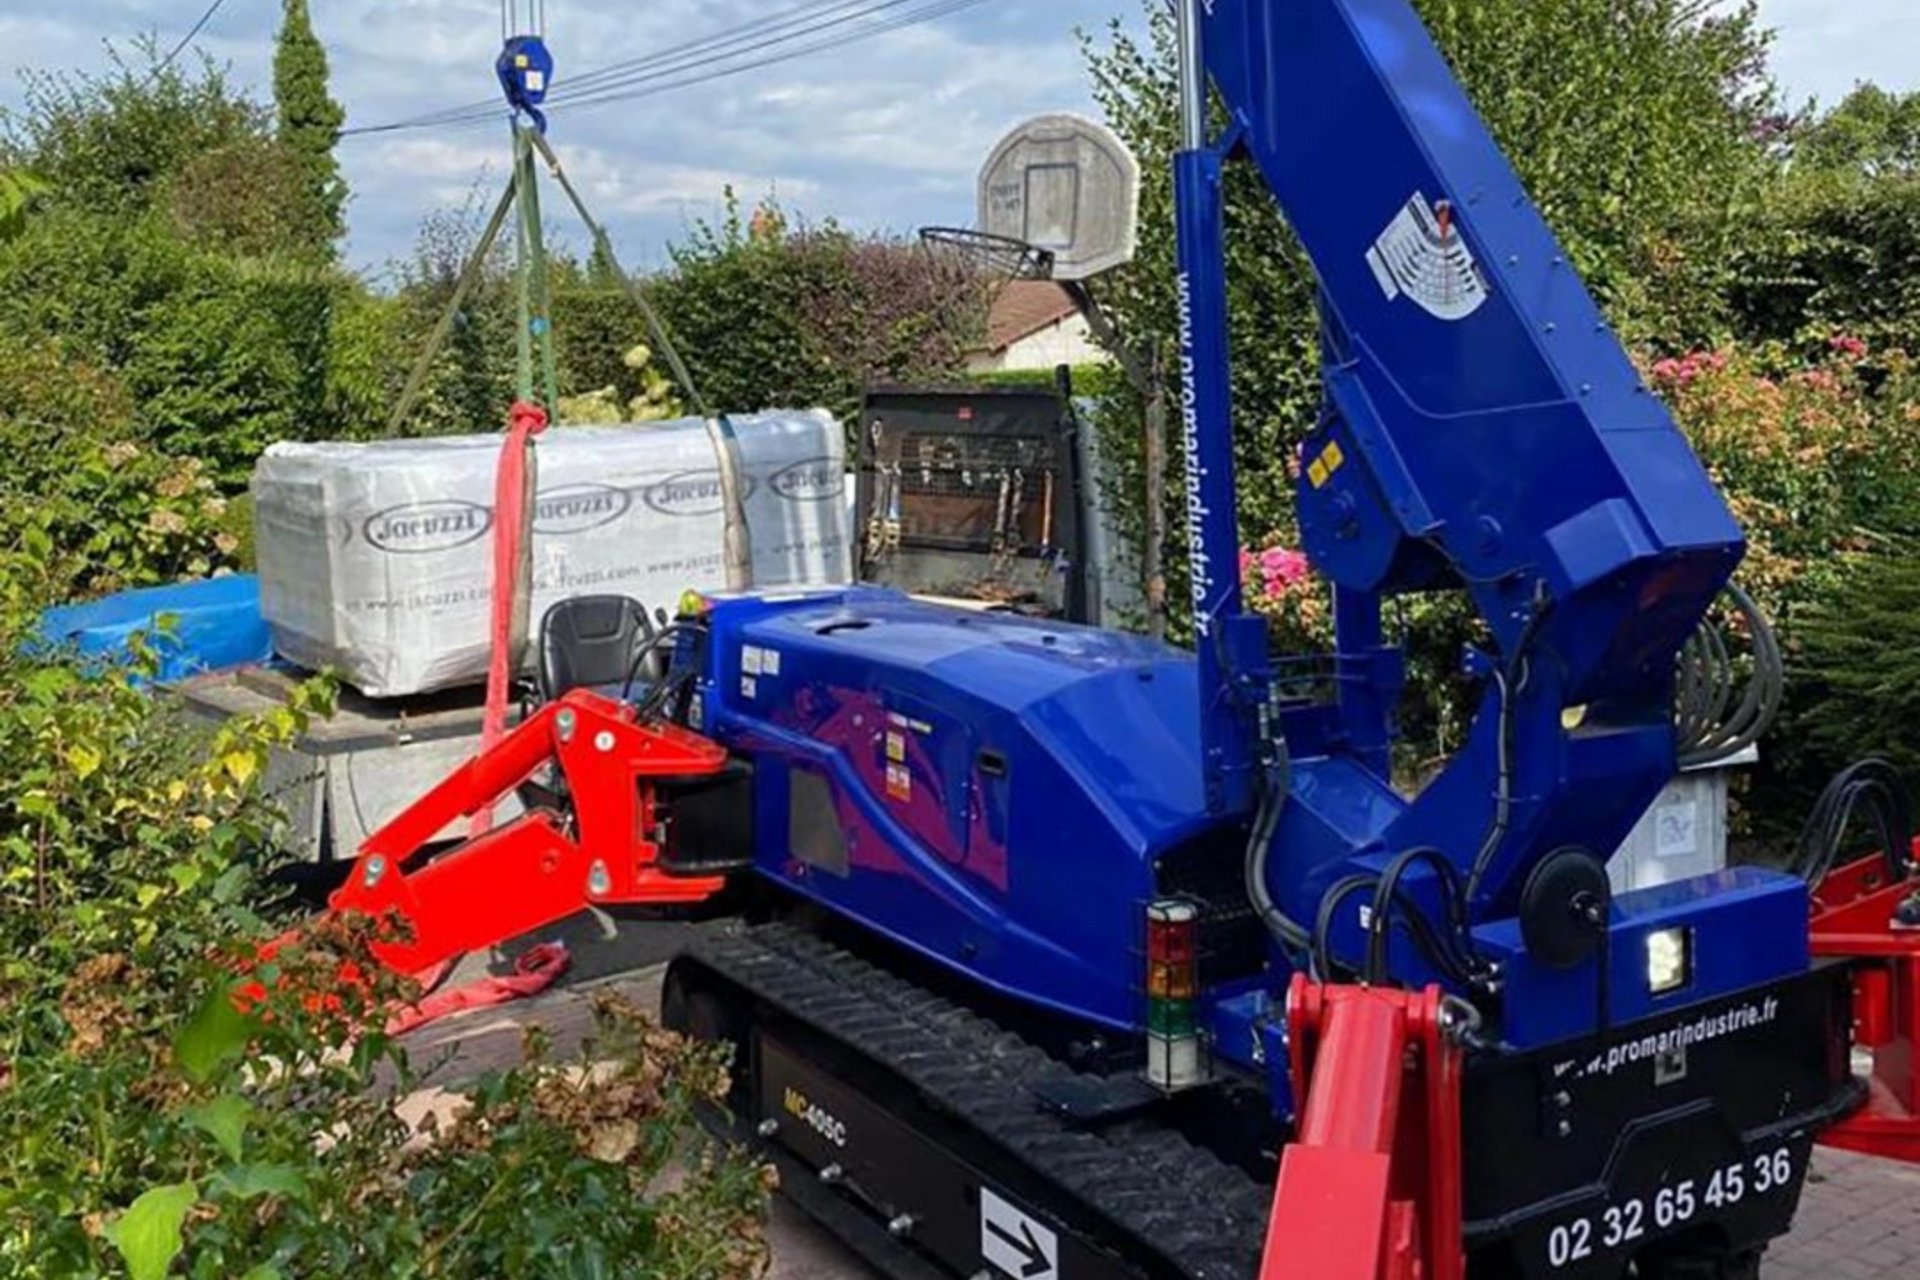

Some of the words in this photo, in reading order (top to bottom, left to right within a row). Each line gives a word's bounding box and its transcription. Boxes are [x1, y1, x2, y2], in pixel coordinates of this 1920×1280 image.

[537, 494, 614, 520] acuzzi
[657, 480, 720, 505] Jacuz
[375, 509, 478, 541] Jacuzzi
[1553, 996, 1778, 1077] ww.promarindustrie.fr
[1549, 1218, 1591, 1267] 02
[1603, 1199, 1644, 1246] 32
[1655, 1180, 1695, 1228] 65
[1704, 1164, 1744, 1208] 45
[1753, 1148, 1791, 1194] 36
